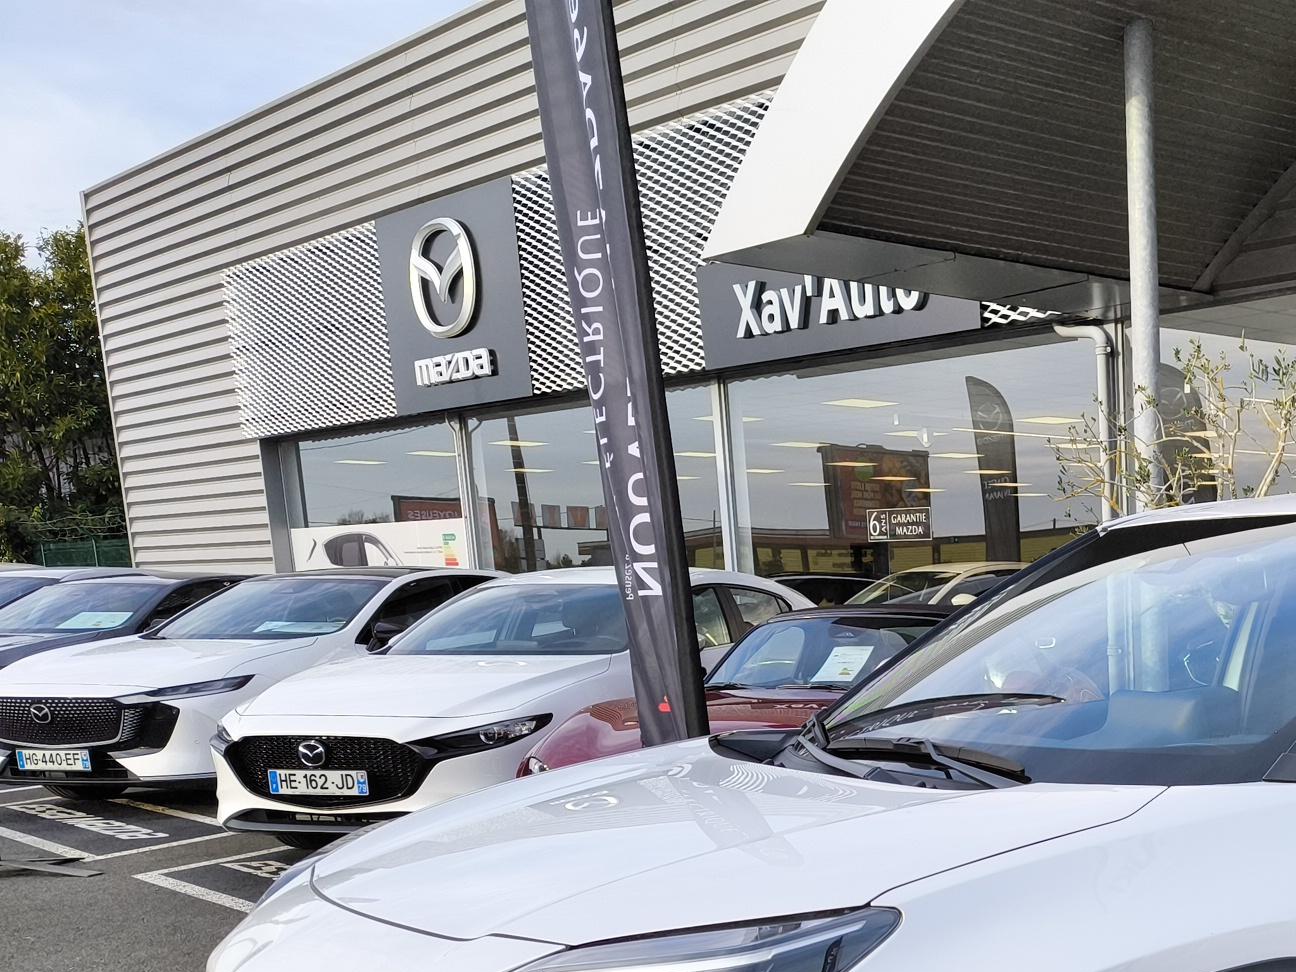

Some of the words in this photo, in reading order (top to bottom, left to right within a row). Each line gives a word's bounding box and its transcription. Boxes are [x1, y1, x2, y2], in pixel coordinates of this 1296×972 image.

[732, 274, 920, 339] Xav'Auto
[869, 512, 880, 535] 6
[891, 512, 927, 524] GARANTIE
[895, 525, 924, 536] MAZDA
[24, 752, 80, 767] HG-440-EF
[279, 773, 355, 790] HE-162-JD
